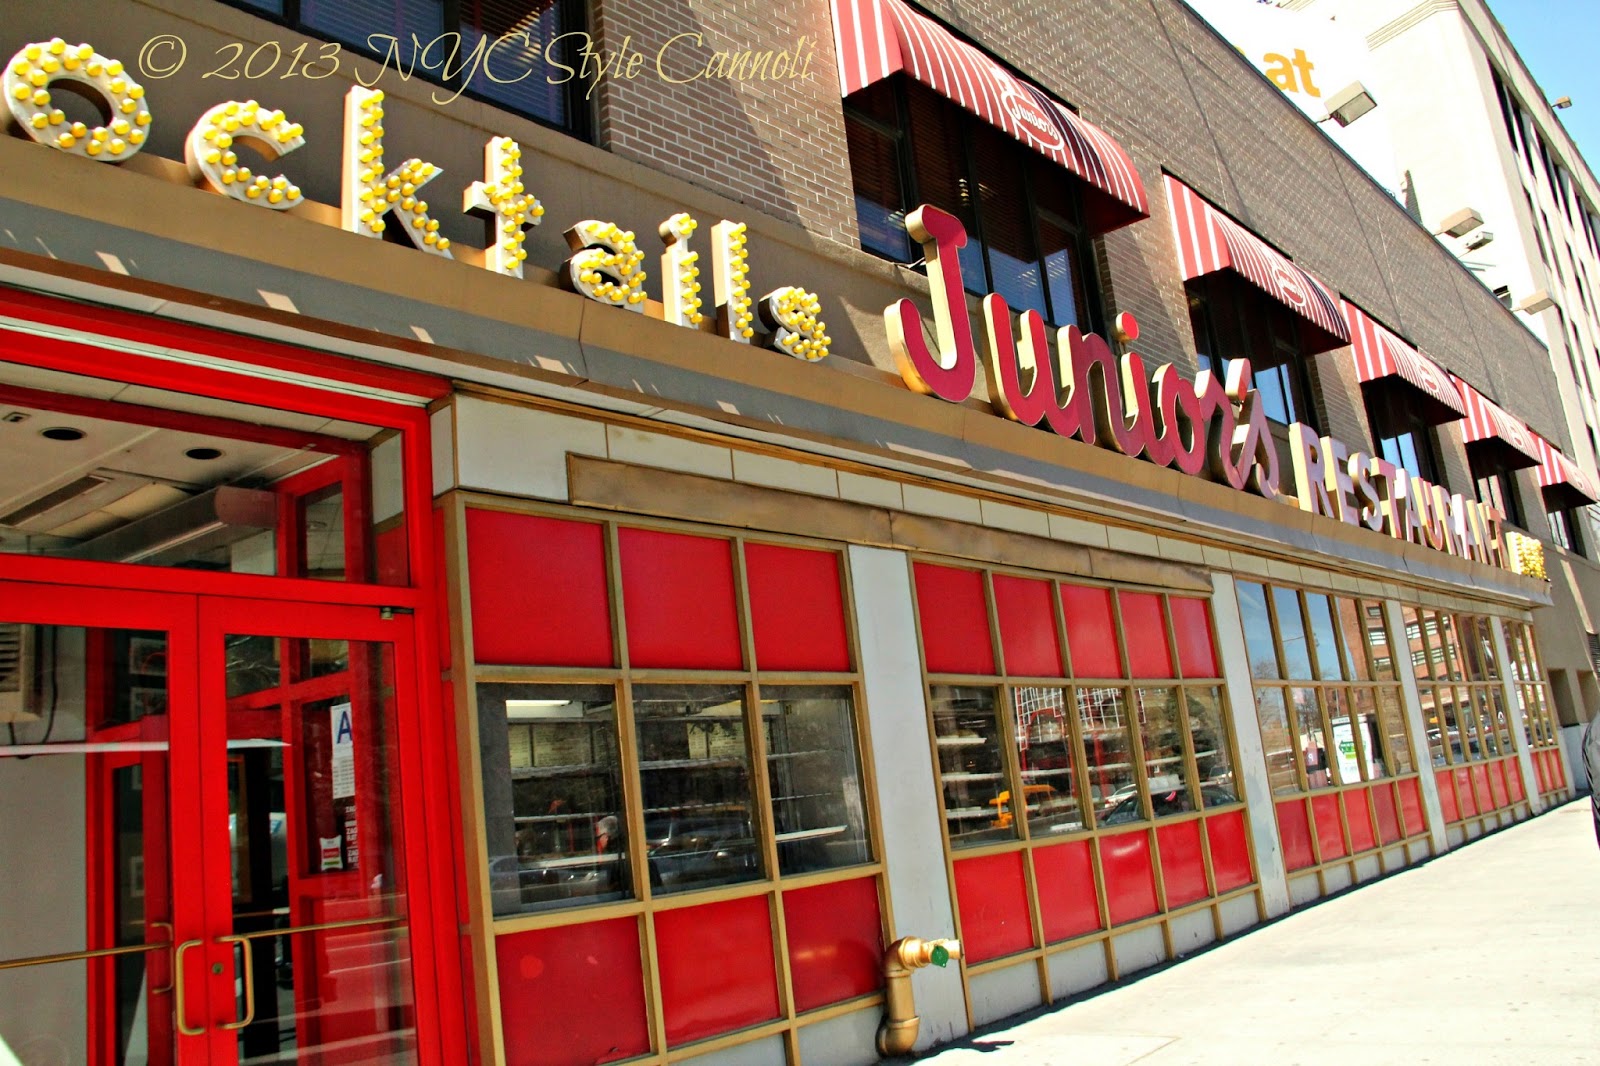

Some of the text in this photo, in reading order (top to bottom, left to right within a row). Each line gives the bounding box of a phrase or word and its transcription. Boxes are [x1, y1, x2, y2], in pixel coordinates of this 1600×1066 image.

[1263, 48, 1321, 98] at
[1, 37, 833, 363] ocktails
[884, 204, 1280, 499] Junior's
[1289, 421, 1508, 572] RESTAURANT
[336, 710, 353, 744] A
